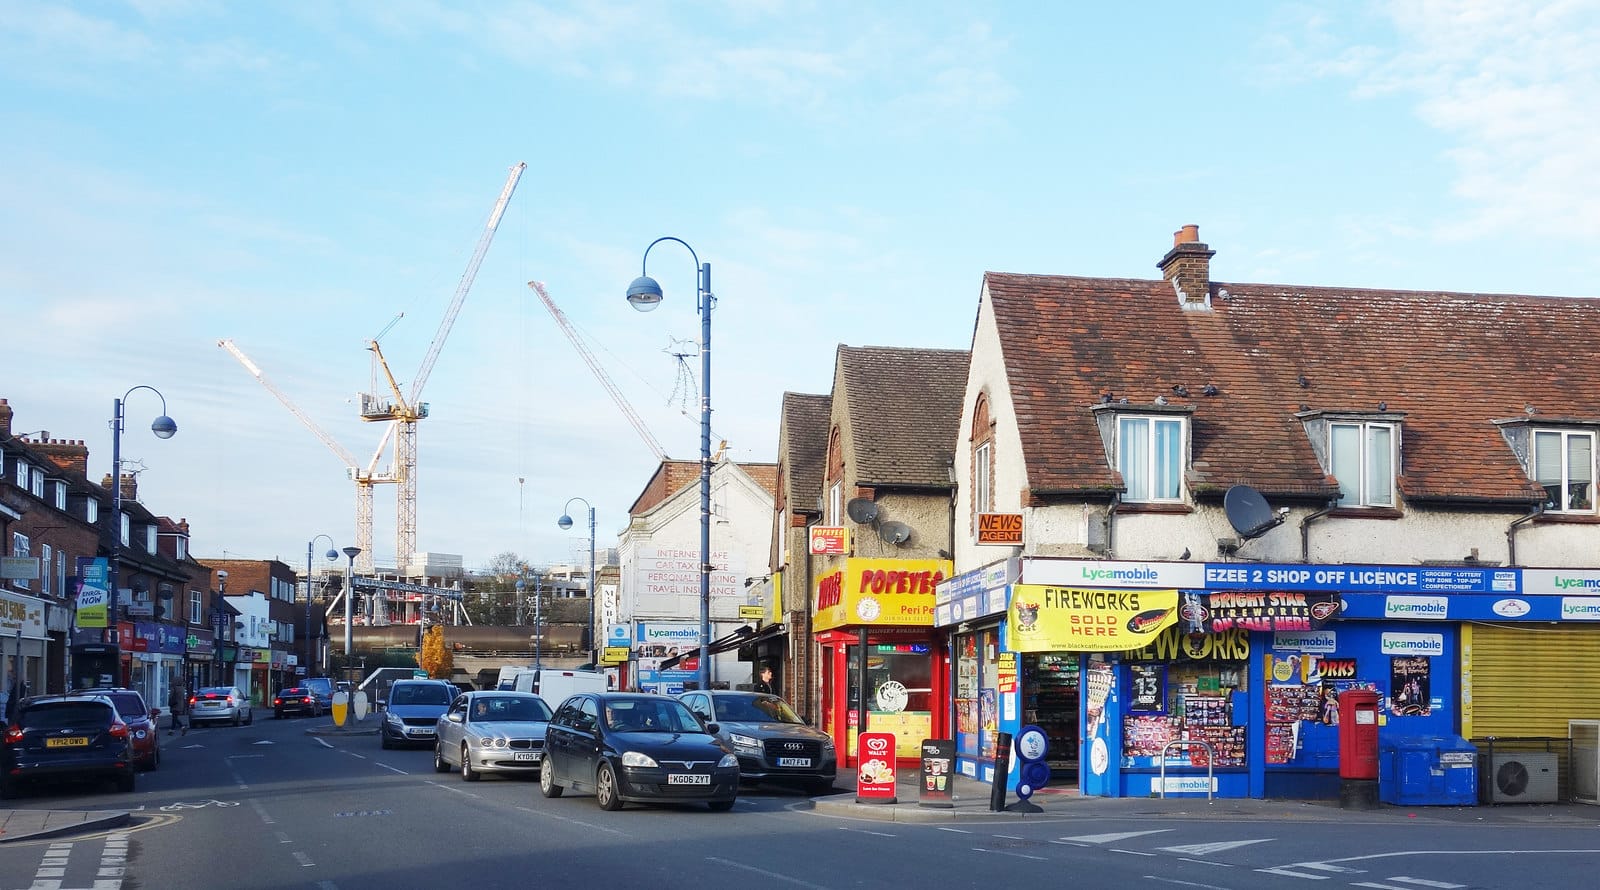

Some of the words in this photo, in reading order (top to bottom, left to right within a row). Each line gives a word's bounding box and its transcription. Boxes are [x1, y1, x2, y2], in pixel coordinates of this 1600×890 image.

[979, 516, 1023, 530] NEWS
[813, 528, 843, 537] POPEYES
[981, 532, 1021, 541] AGENT
[711, 552, 728, 561] AFE
[655, 561, 674, 570] CAR
[677, 562, 694, 570] TAX
[648, 573, 694, 582] PERSONAL
[1082, 566, 1158, 581] Lycamobile
[1206, 569, 1248, 582] EZEE
[1252, 570, 1263, 582] 2
[1267, 570, 1311, 584] SHOP
[1315, 570, 1345, 585] OFF
[1350, 571, 1417, 586] LICENCE
[1495, 573, 1514, 581] oyster
[860, 570, 943, 596] POPEYES
[648, 585, 680, 594] TRAVEL
[82, 596, 102, 605] NOW
[1045, 588, 1140, 612] FIREWORKS
[1210, 592, 1264, 608] BRIGHT
[1270, 592, 1307, 608] STAR
[901, 606, 920, 615] Peri
[923, 606, 936, 615] Pe
[1210, 608, 1310, 618] FIREWORKS
[1387, 602, 1446, 614] Lycamobile
[1070, 615, 1118, 626] SOLD
[1212, 619, 1234, 632] ON
[1237, 618, 1271, 632] SALE
[1275, 618, 1311, 631] HERE
[1018, 623, 1036, 632] Cat
[1071, 627, 1118, 637] HERE
[649, 628, 700, 638] Lycamobile
[1276, 636, 1334, 648] Lycamobile
[1383, 639, 1442, 651] Lycamobile
[1135, 678, 1158, 696] 13
[674, 776, 694, 784] KG06
[695, 776, 710, 784] ZYT
